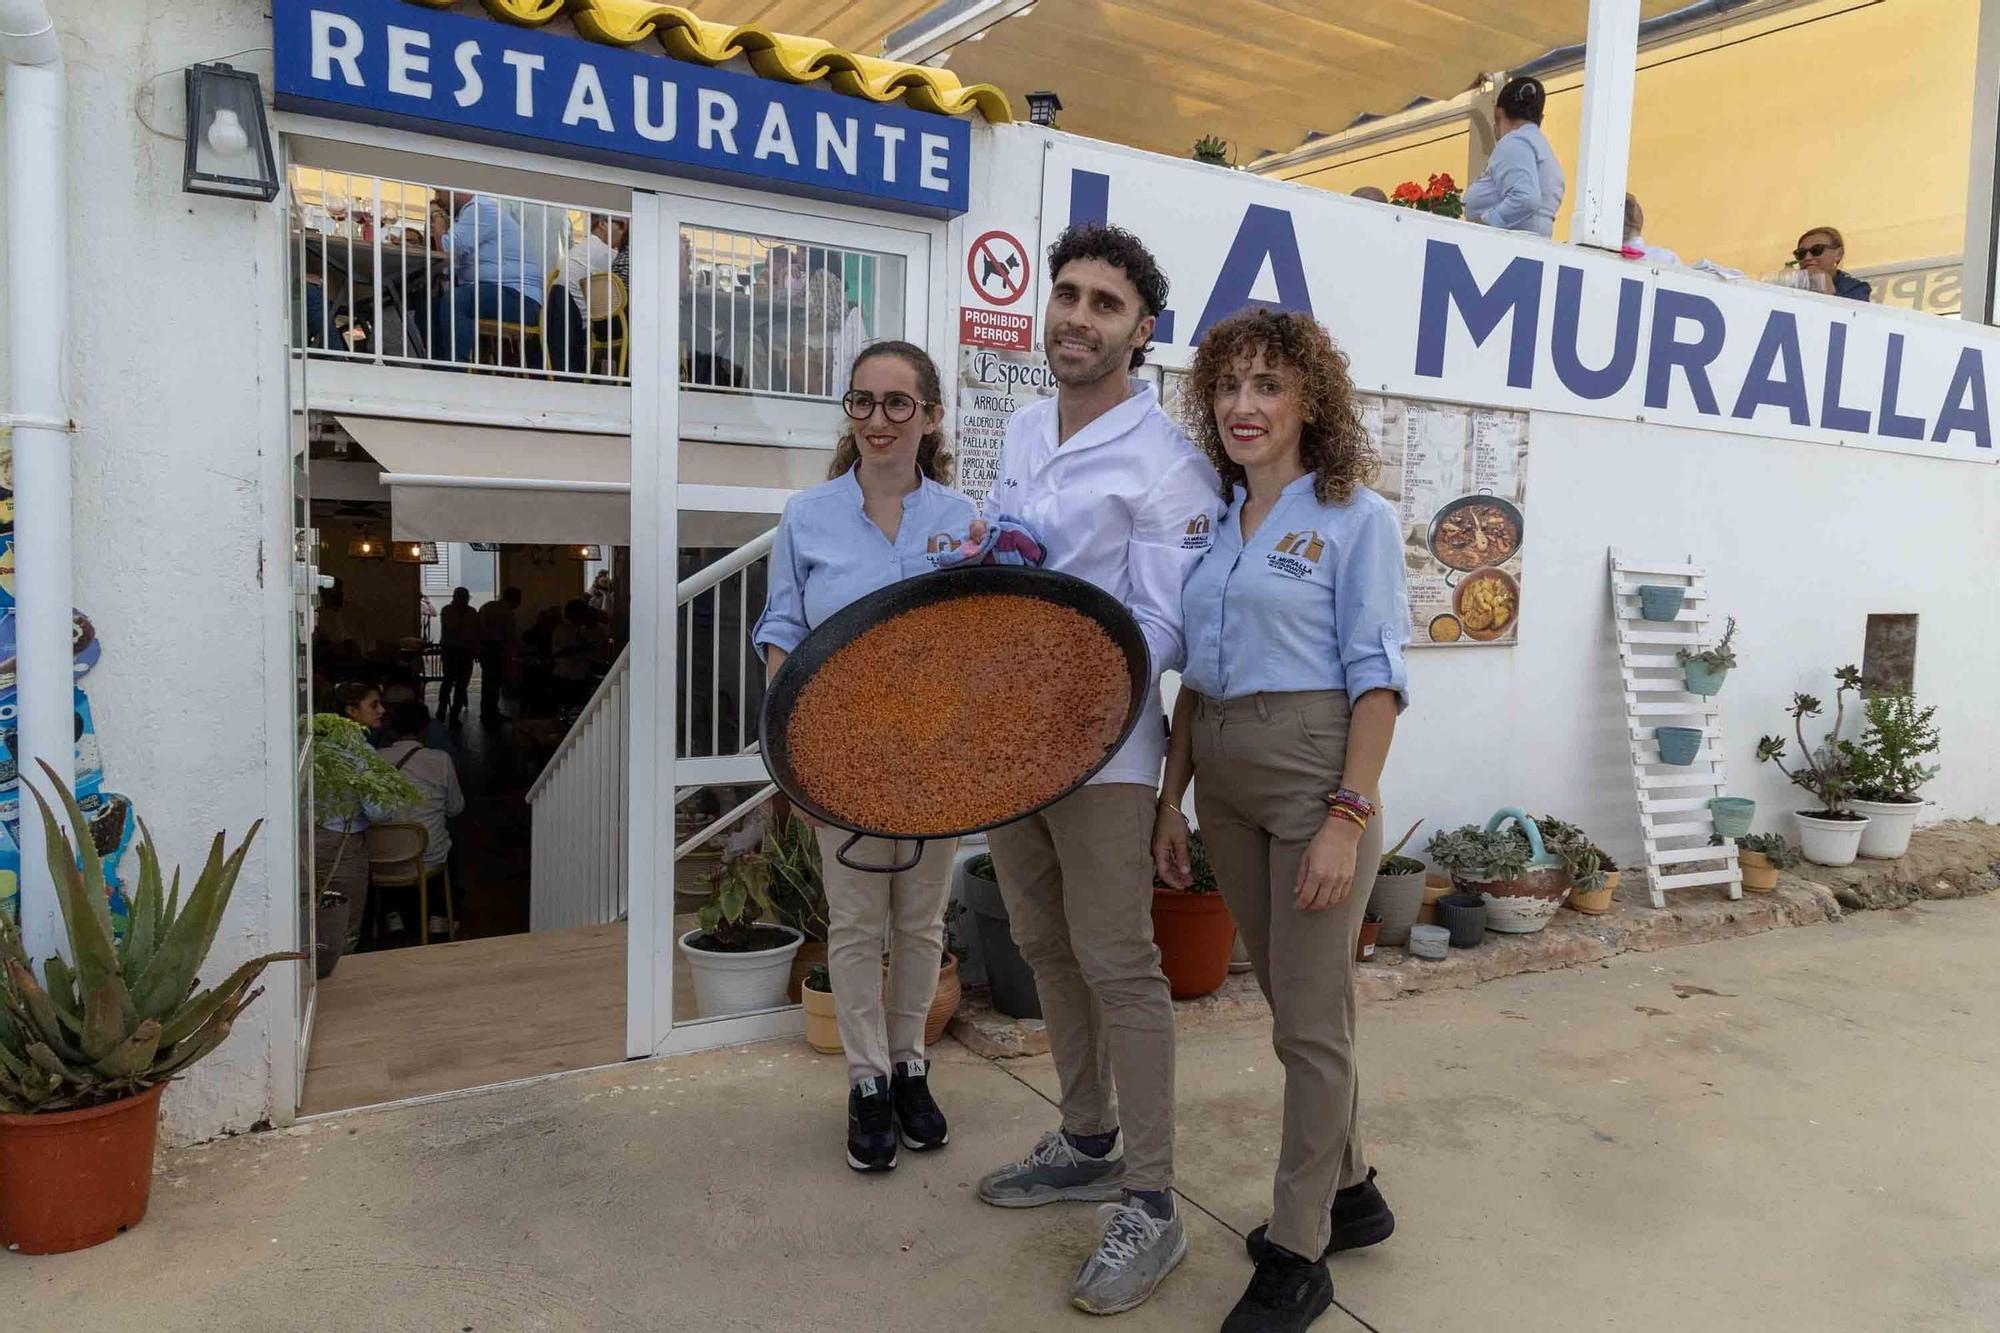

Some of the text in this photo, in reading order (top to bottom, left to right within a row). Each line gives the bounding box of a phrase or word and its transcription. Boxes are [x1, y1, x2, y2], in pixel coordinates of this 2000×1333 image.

[311, 10, 949, 192] RESTAURANTE
[965, 311, 1028, 329] PROHIBIDO
[974, 326, 1019, 343] PERROS
[1415, 239, 1992, 449] MURALLA
[974, 395, 1015, 413] ARROCES
[963, 415, 994, 428] CALDERO
[996, 418, 1005, 429] DE
[962, 436, 988, 448] PAELLA
[990, 438, 998, 449] DE
[963, 457, 984, 469] ARROZ
[962, 468, 971, 479] DE
